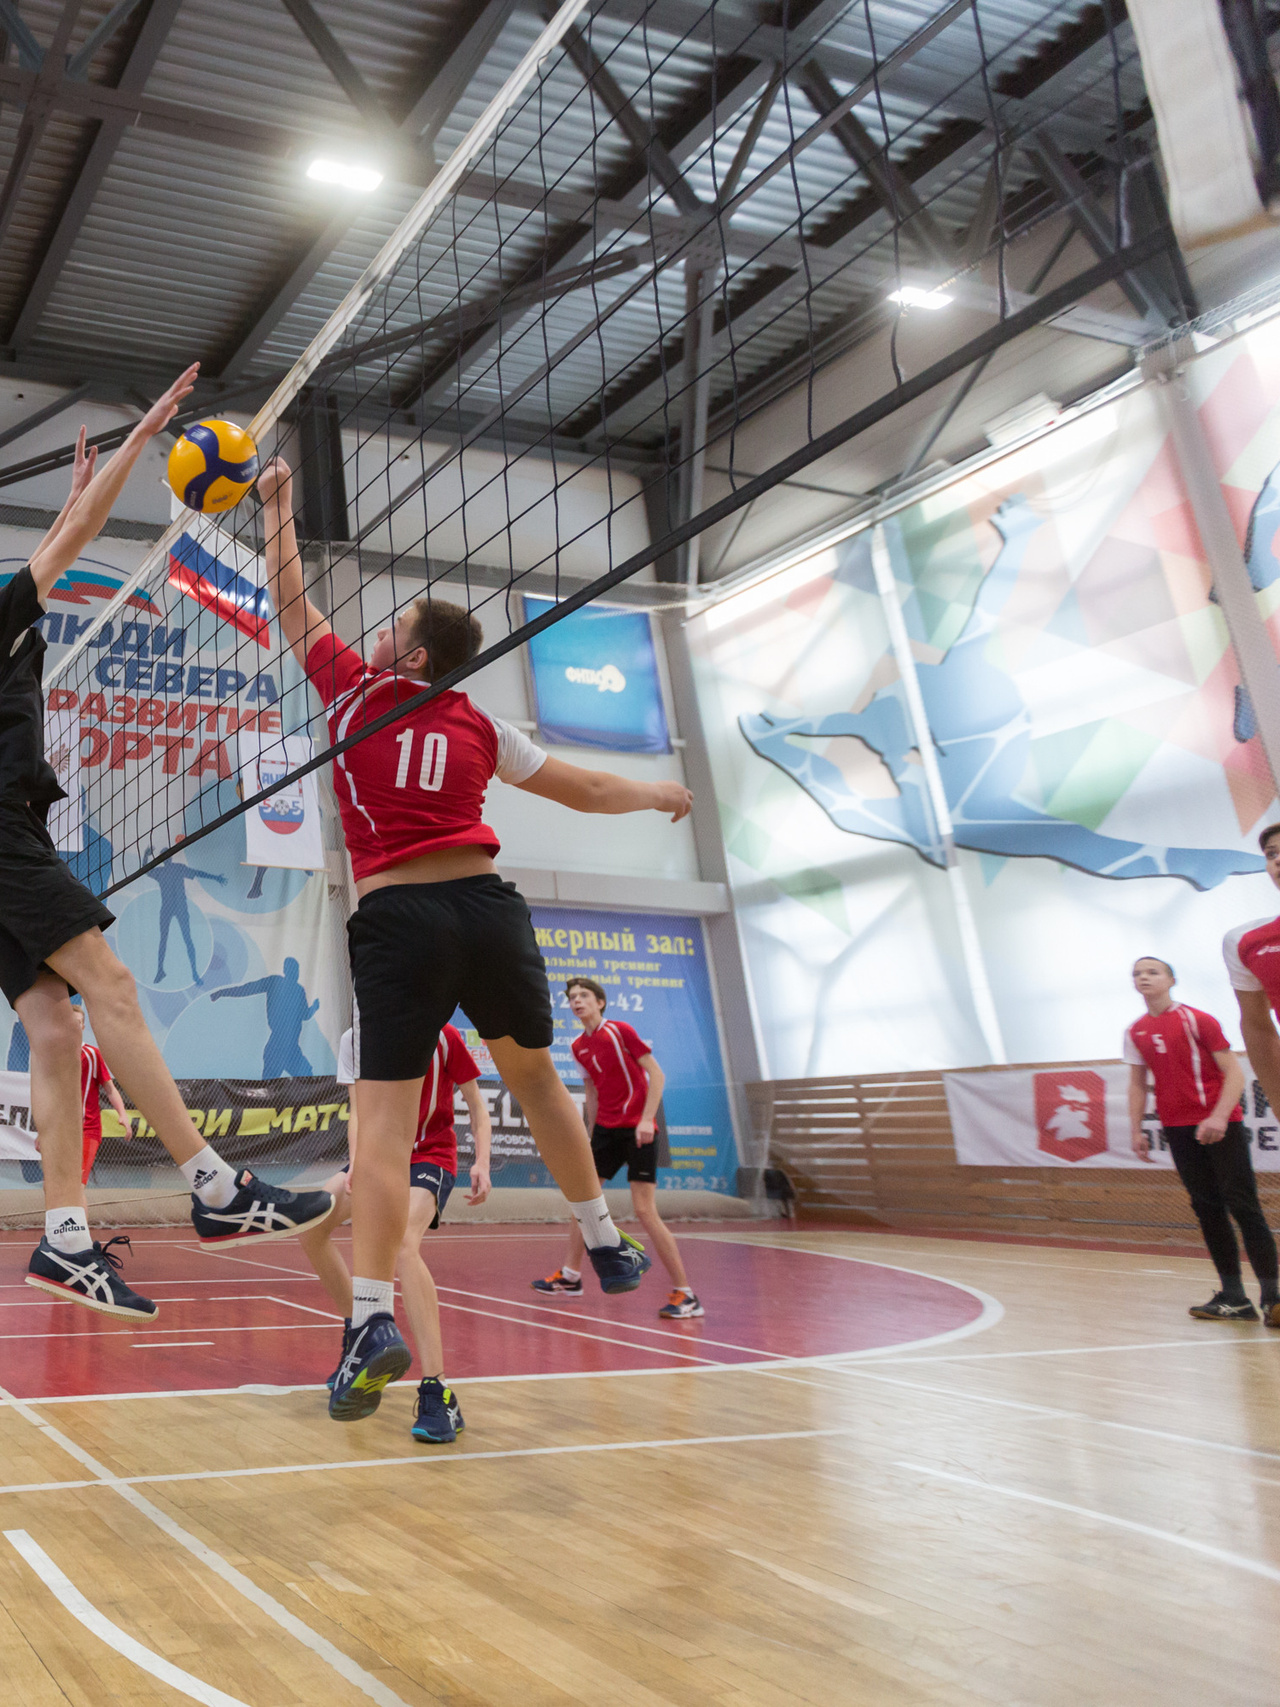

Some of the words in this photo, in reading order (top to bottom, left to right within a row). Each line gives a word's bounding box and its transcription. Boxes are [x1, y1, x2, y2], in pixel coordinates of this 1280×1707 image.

[33, 611, 188, 659] ЛЮДИ
[94, 656, 281, 704] СЕВЕРА
[47, 688, 282, 734] РАЗВИТИЕ
[395, 727, 448, 791] 10
[646, 934, 695, 956] зал:
[604, 959, 662, 972] тренинг
[627, 976, 686, 989] тренинг
[193, 1168, 219, 1190] adidas
[53, 1224, 86, 1236] adidas
